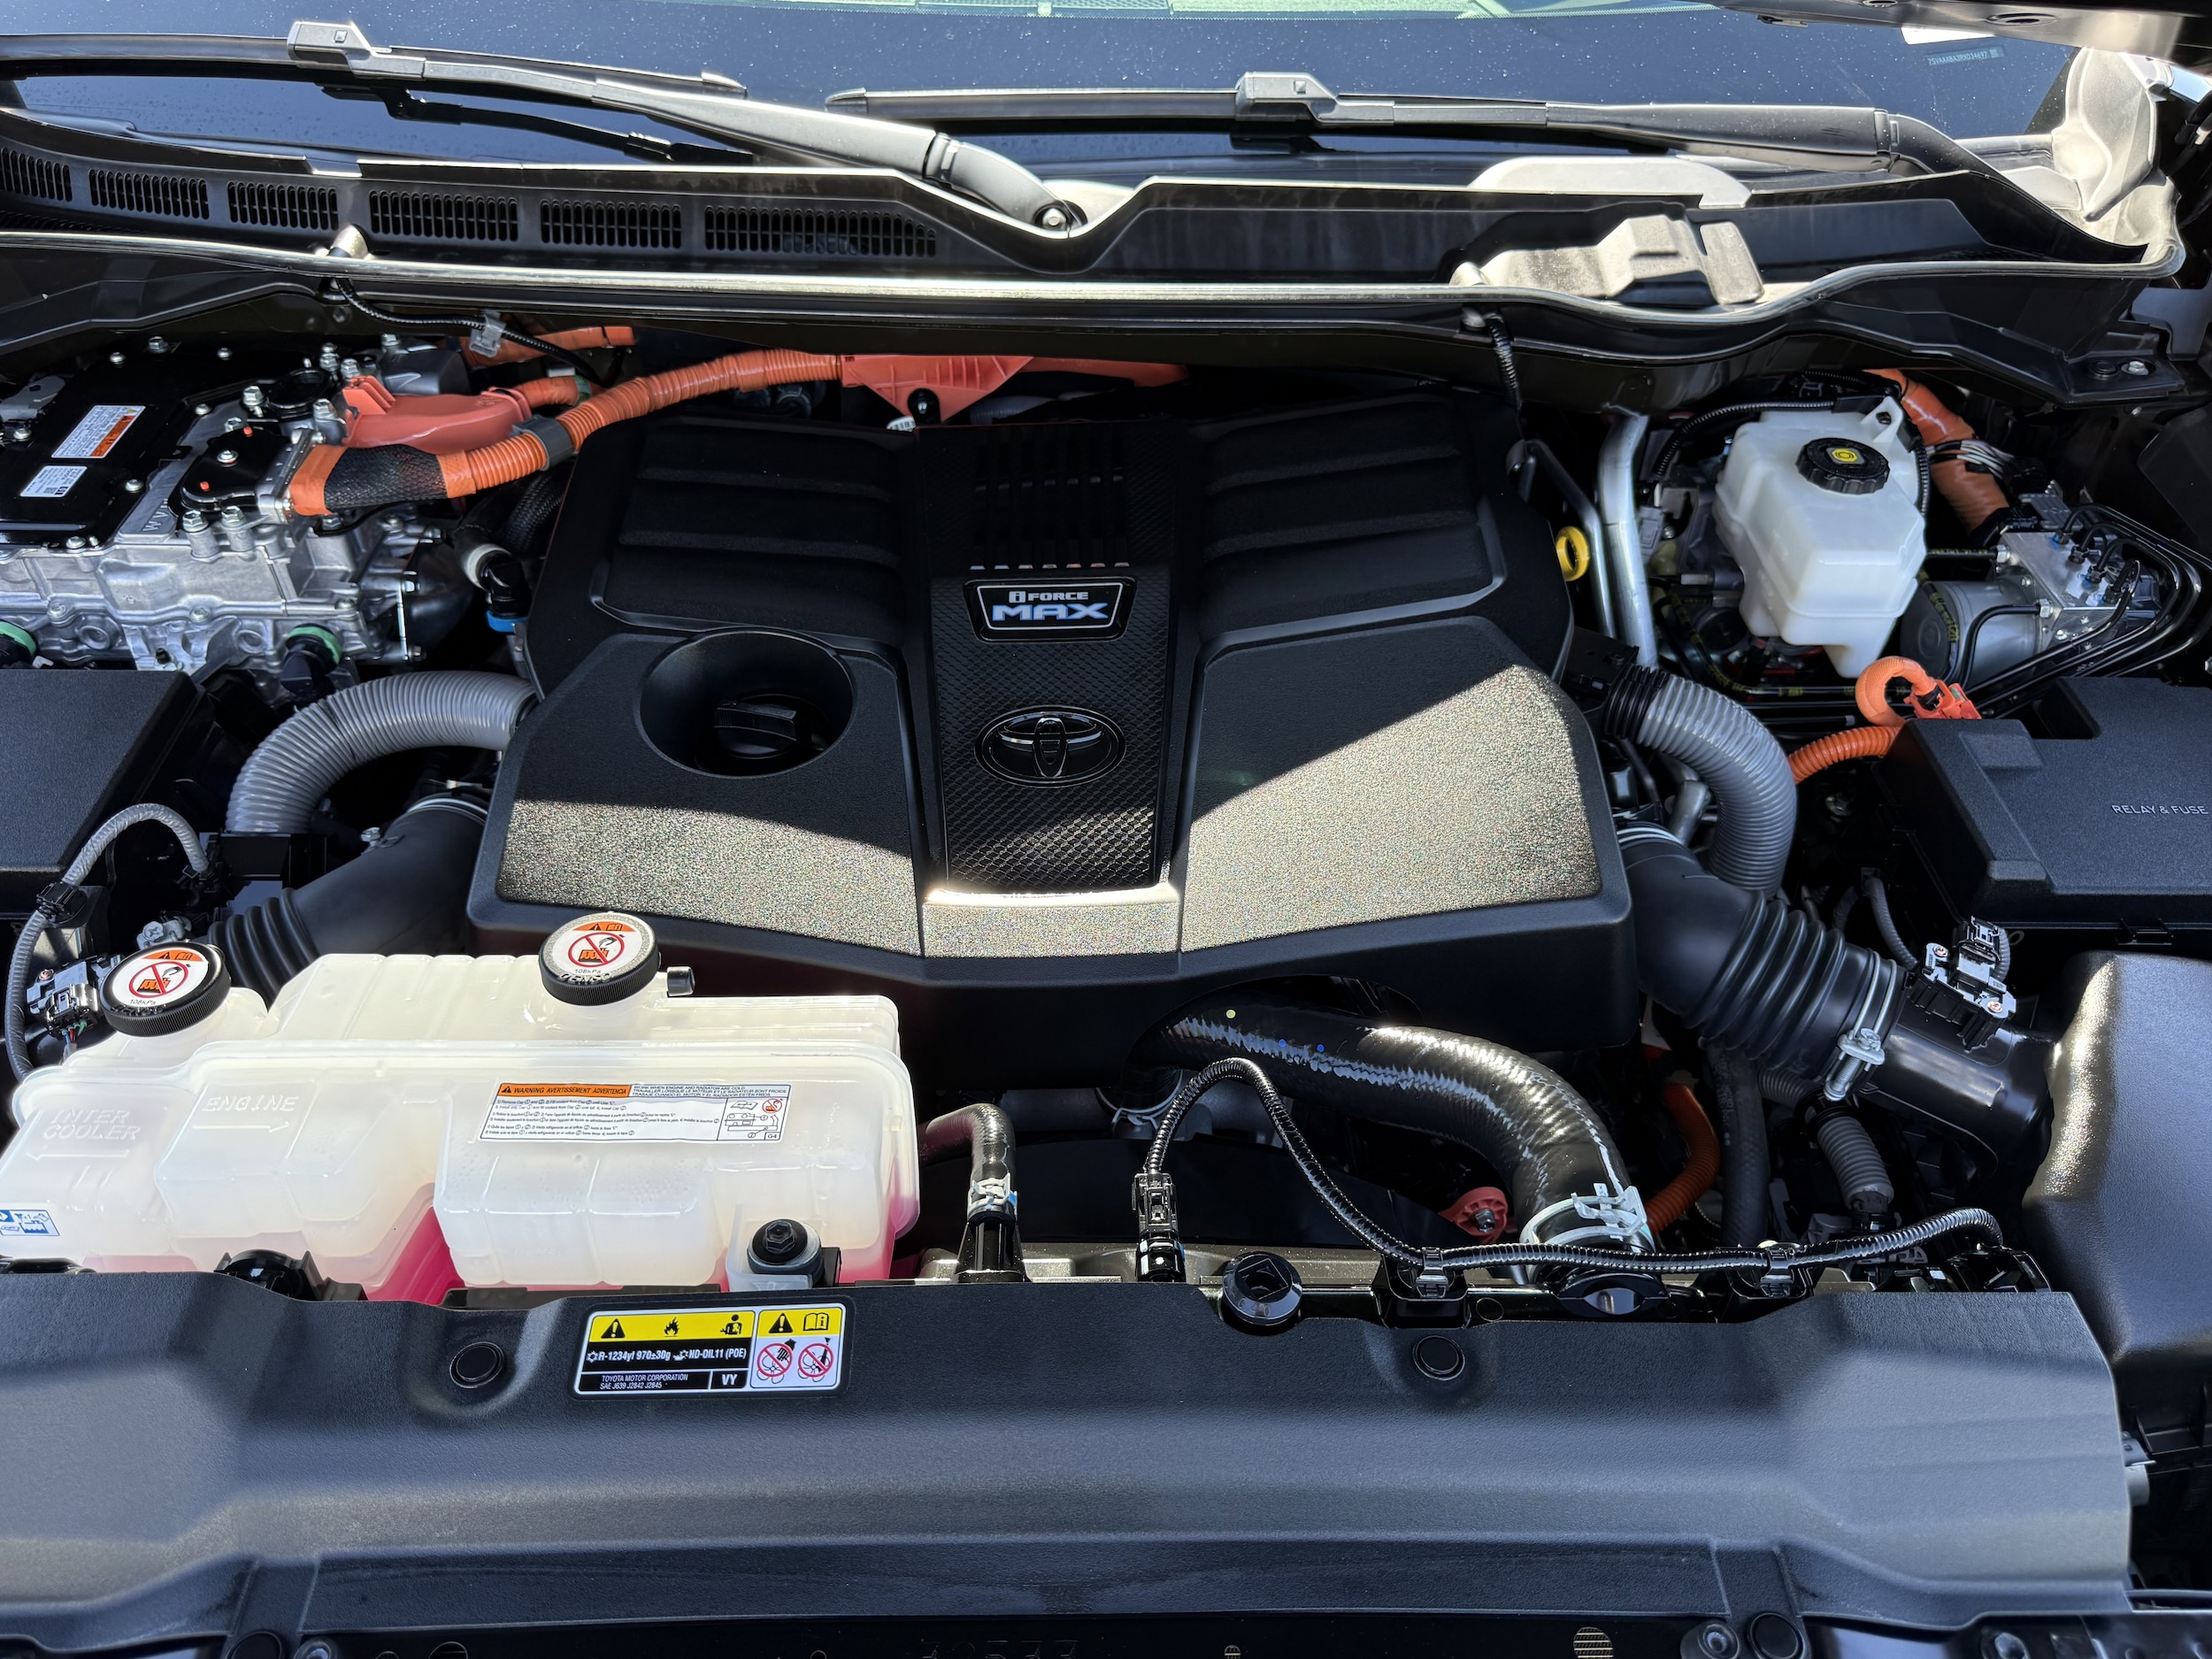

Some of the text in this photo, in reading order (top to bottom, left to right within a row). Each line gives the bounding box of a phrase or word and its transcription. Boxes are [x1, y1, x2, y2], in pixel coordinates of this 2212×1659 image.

[1028, 591, 1088, 602] FORCE
[992, 603, 1109, 621] MAX
[2111, 805, 2209, 814] RELAY & FUSE
[202, 1095, 299, 1111] ENGINE
[50, 1110, 131, 1124] INTER
[43, 1124, 141, 1140] COOLER
[598, 1350, 671, 1362] R-1234yf 970±30g
[688, 1348, 747, 1359] ND-OIL11 (POE)
[722, 1374, 738, 1385] VY
